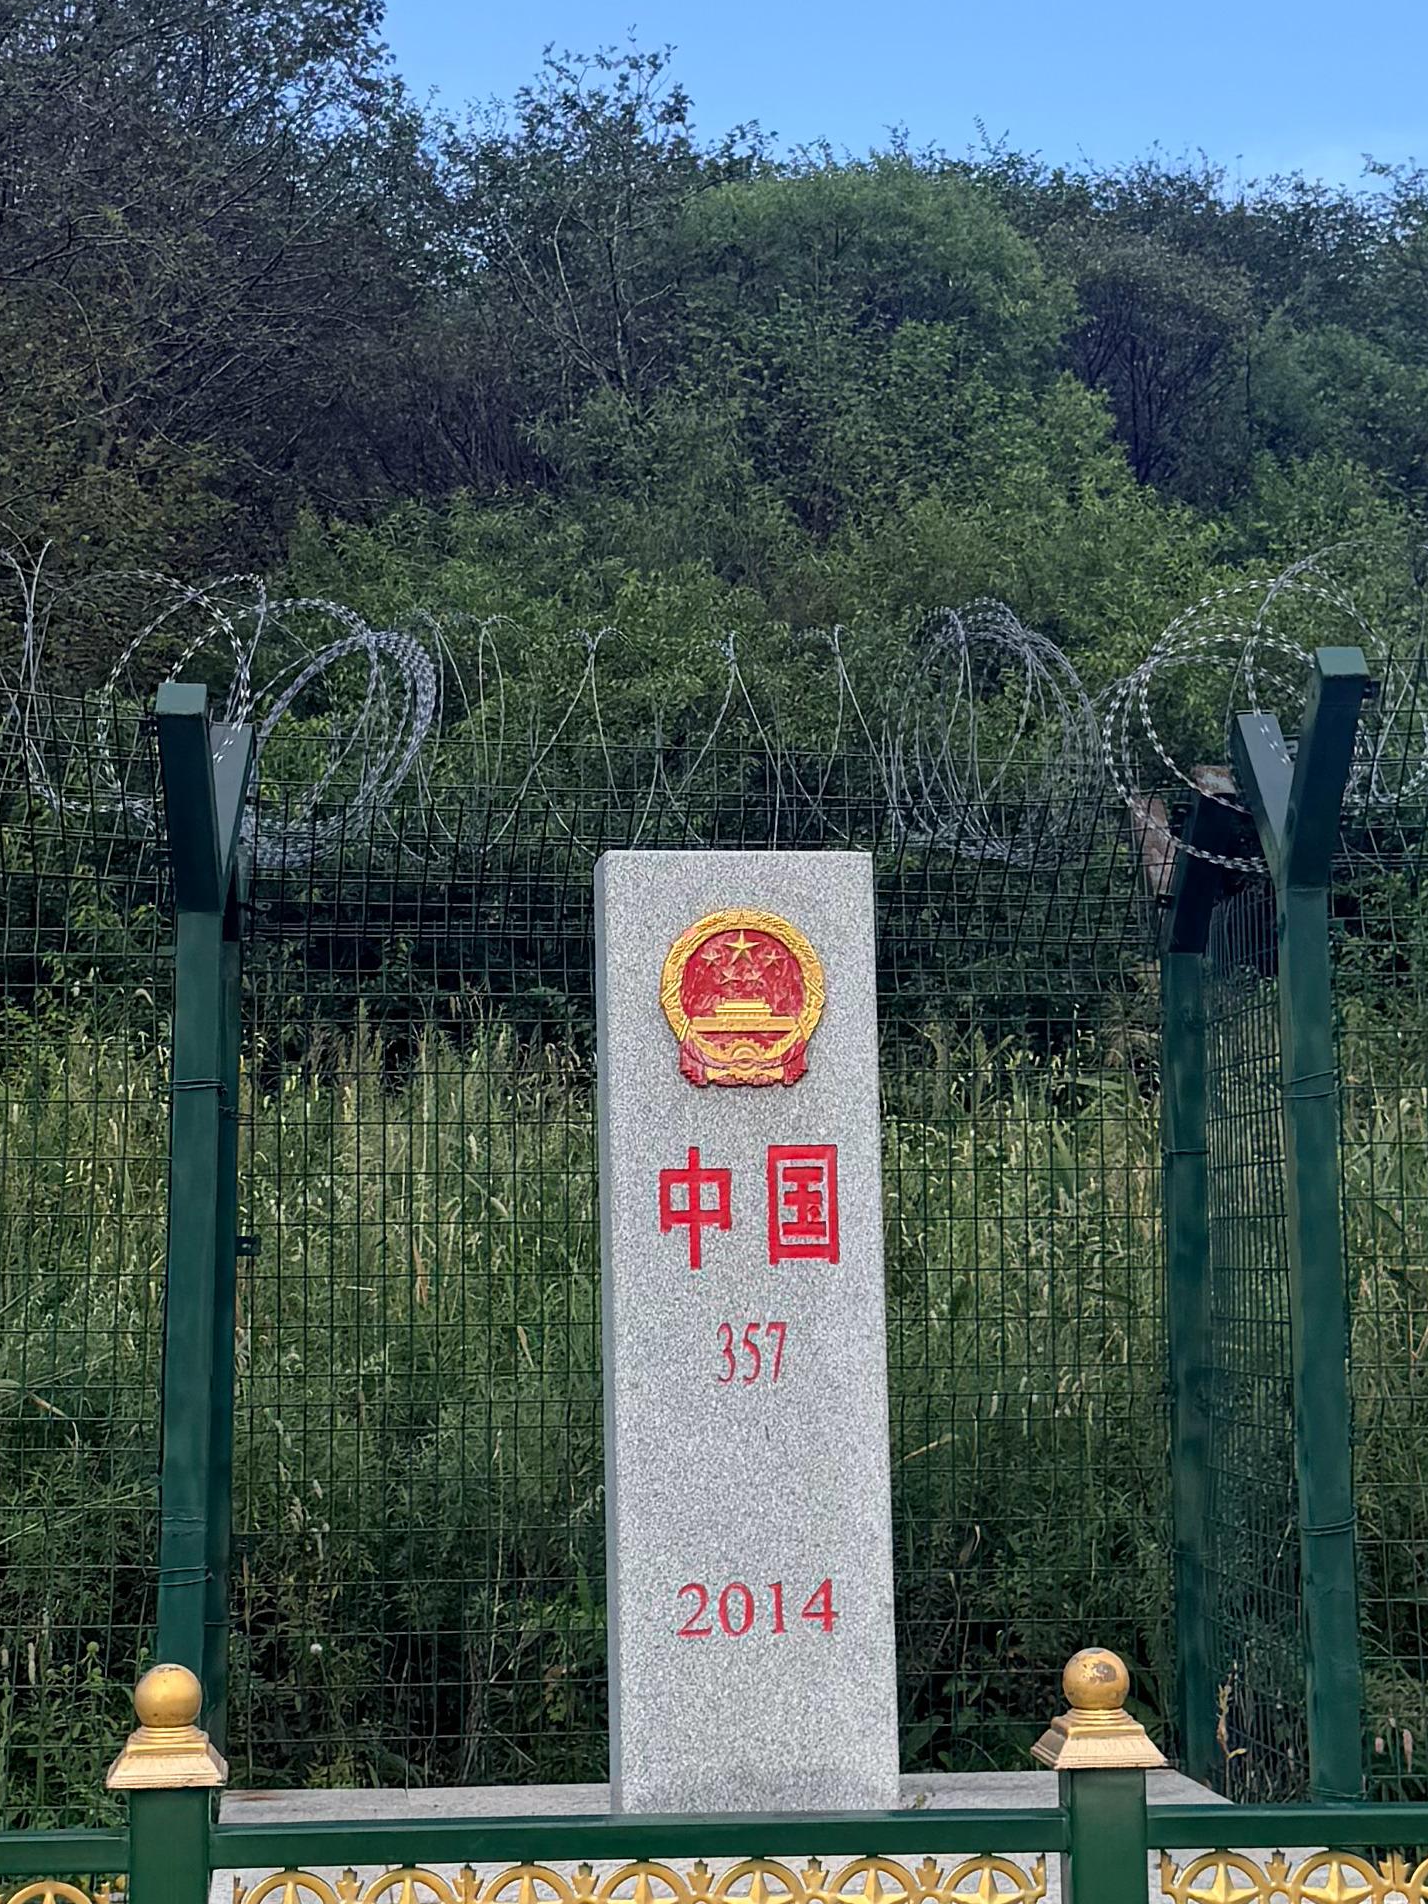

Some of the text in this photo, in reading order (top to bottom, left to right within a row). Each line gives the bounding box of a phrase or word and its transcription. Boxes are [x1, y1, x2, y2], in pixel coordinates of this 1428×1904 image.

[657, 1143, 841, 1271] 中国
[716, 1321, 788, 1386] 357
[676, 1577, 840, 1639] 2014
